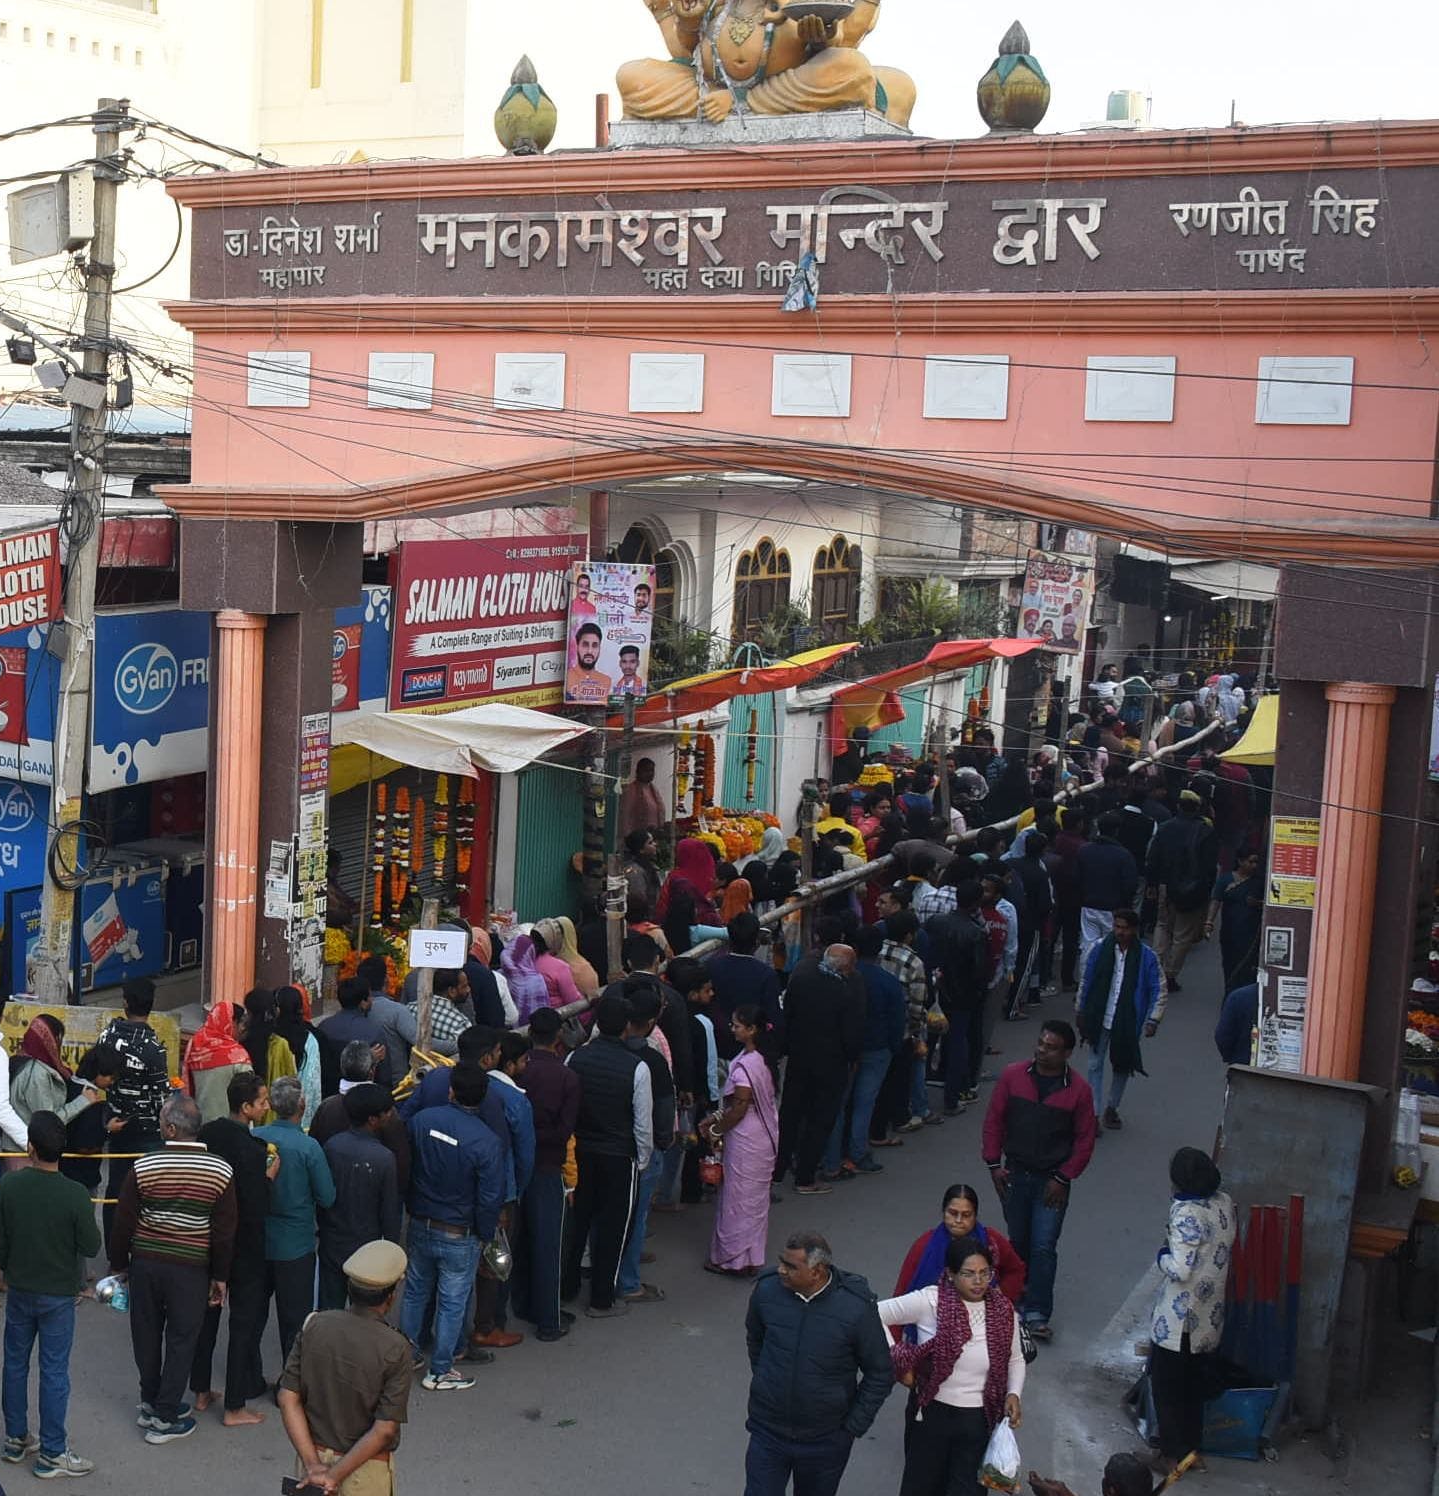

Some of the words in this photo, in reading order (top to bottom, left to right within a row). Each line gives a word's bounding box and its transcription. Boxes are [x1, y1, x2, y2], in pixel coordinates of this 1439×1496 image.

[417, 194, 727, 268] मनकामेश्वर
[766, 186, 949, 266] मन्दिर
[992, 197, 1107, 266] द्वार
[1169, 186, 1289, 237] रणजीत
[334, 211, 383, 253] शर्मा
[1236, 239, 1307, 273] पार्षद
[405, 576, 478, 625] SALMAN
[479, 571, 530, 618] CLOTH
[530, 568, 569, 614] HOUS
[430, 636, 437, 649] A
[438, 631, 469, 650] Complete
[471, 632, 492, 648] Range
[493, 629, 501, 642] of
[501, 626, 523, 643] Suiting
[524, 626, 530, 639] &
[530, 623, 554, 640] Shirting
[120, 646, 173, 705] Gyan
[412, 674, 442, 690] DONEAR
[0, 755, 53, 775] DALIGANJ
[424, 941, 449, 957] पुरुष
